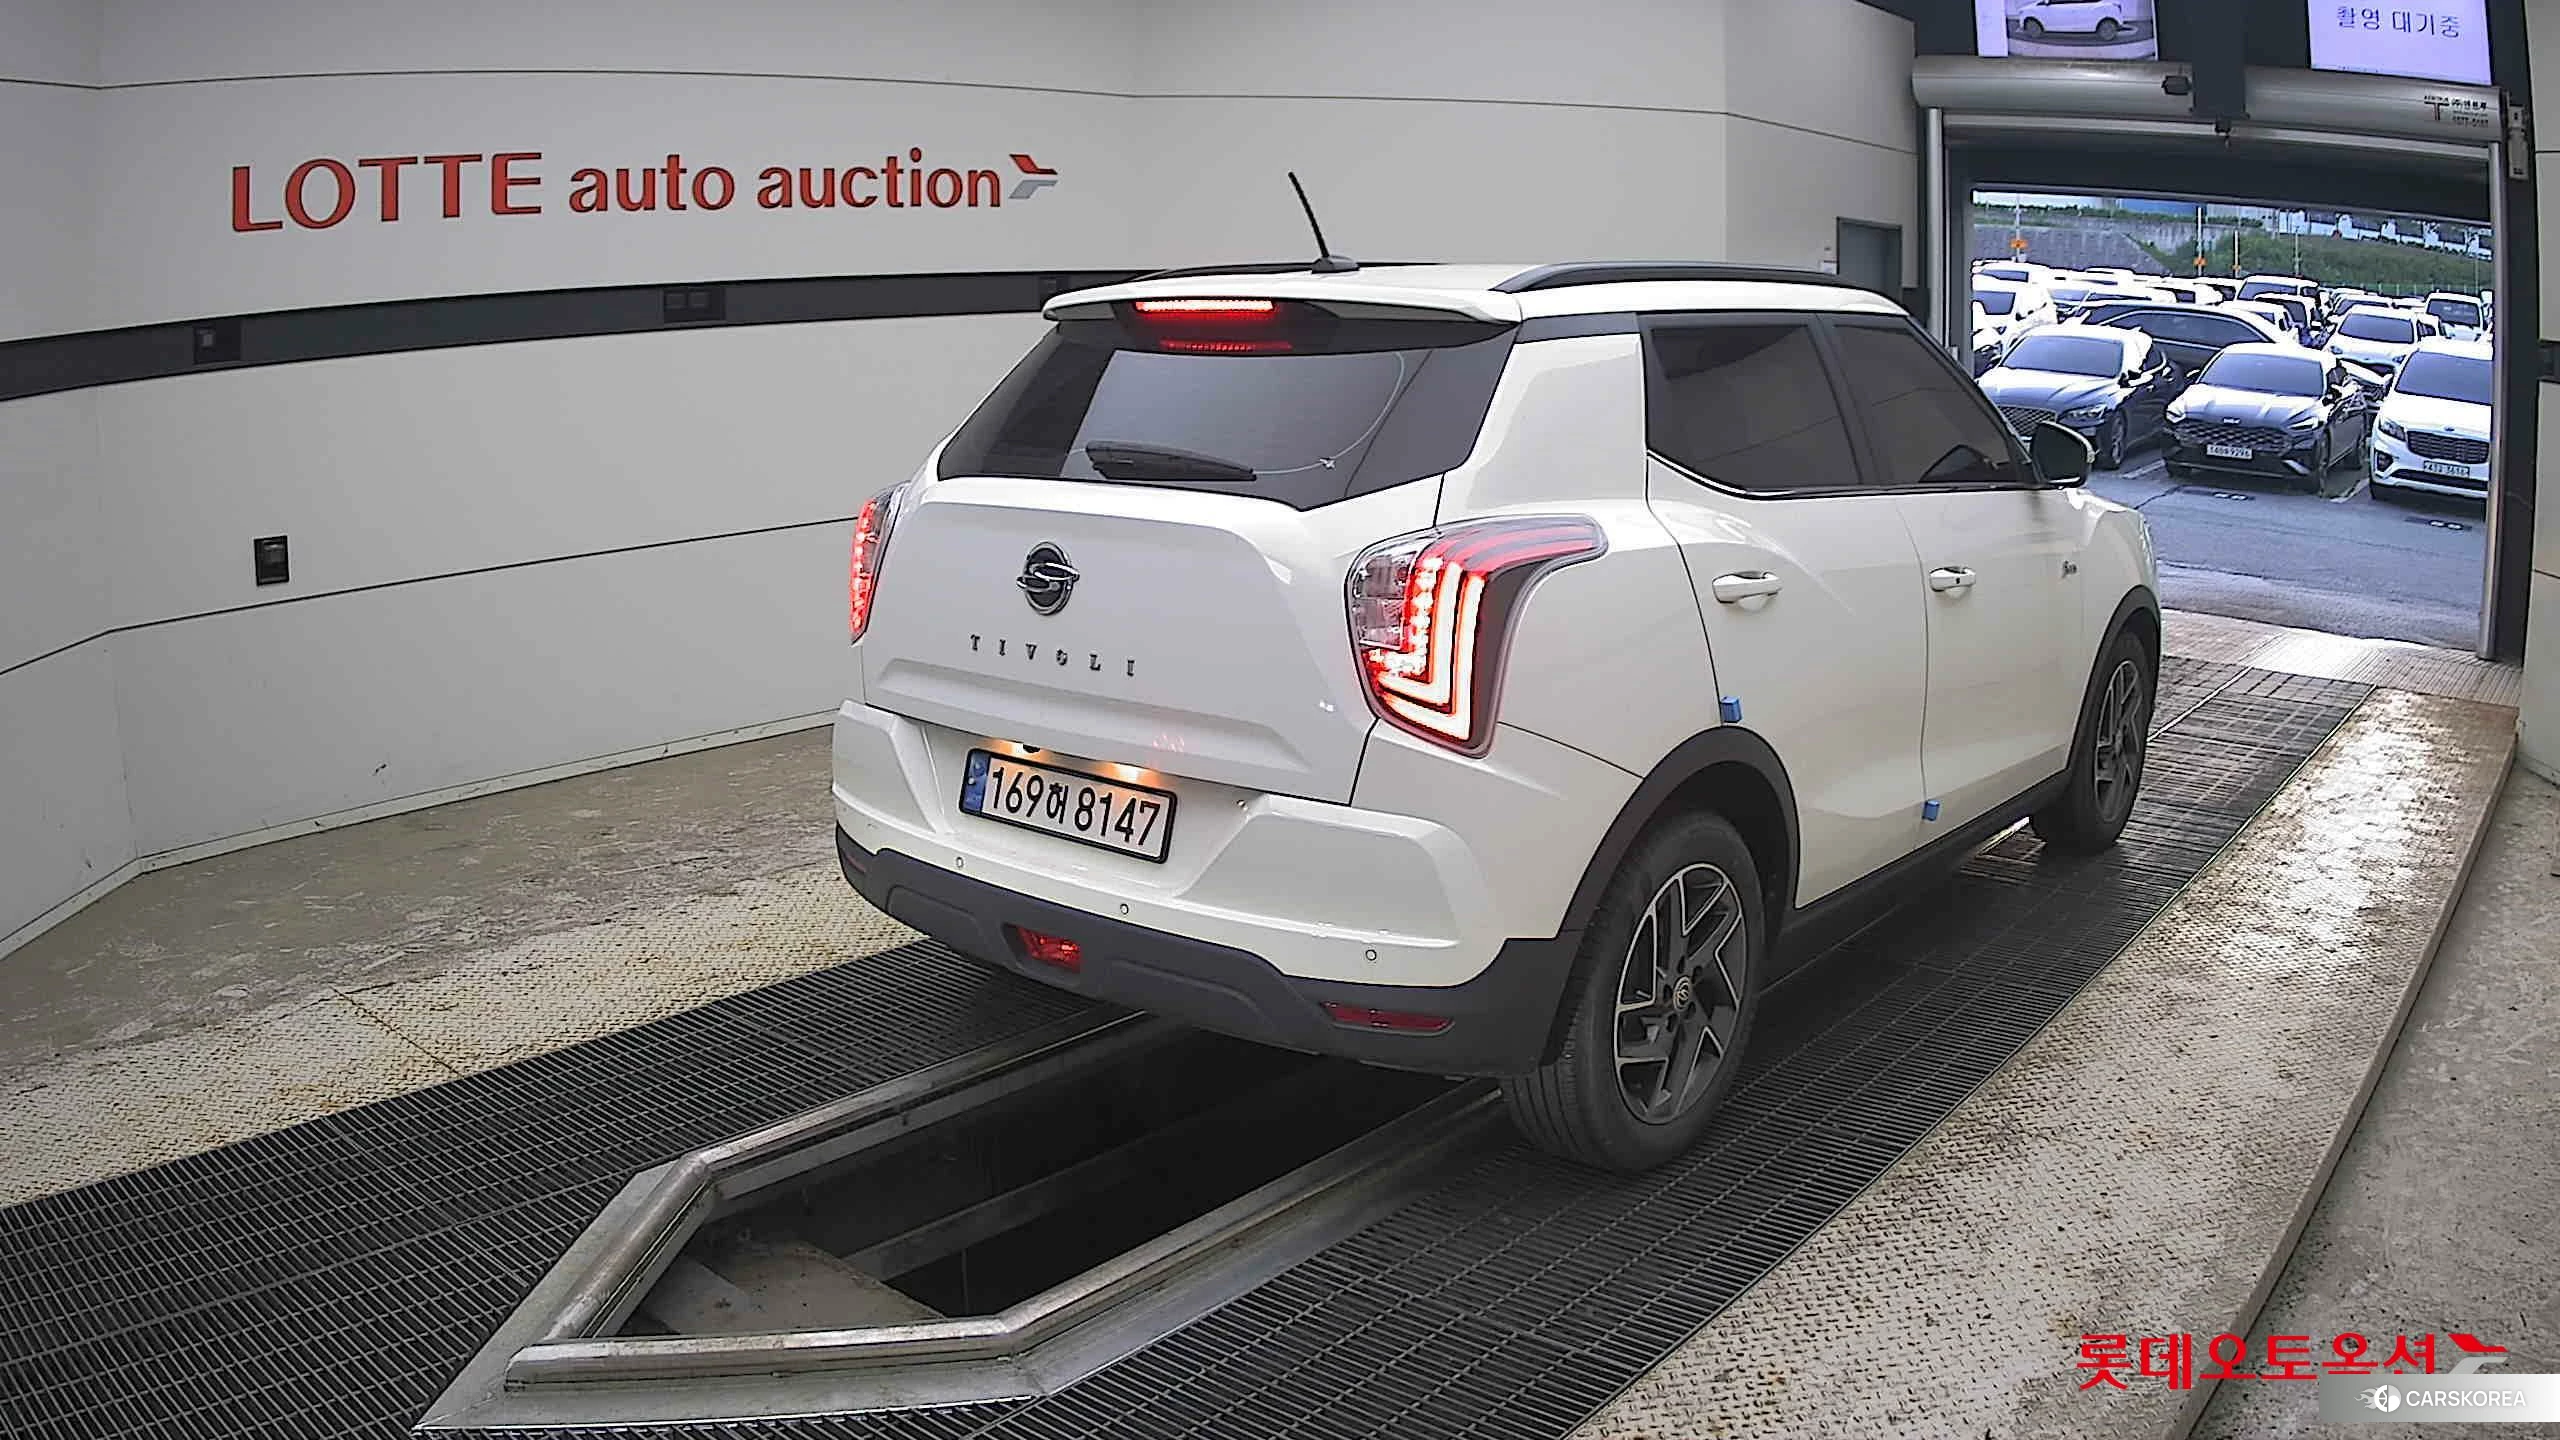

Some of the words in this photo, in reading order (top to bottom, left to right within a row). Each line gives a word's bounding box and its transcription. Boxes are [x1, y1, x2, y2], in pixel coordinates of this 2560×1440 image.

[2337, 6, 2380, 30] 촬영
[2392, 11, 2460, 38] 대기중
[233, 152, 541, 232] LOTTE
[568, 153, 735, 212] auto
[757, 147, 1001, 208] auction
[969, 634, 1135, 677] TIVOLI
[992, 766, 1069, 825] 169허
[1073, 786, 1161, 846] 8147
